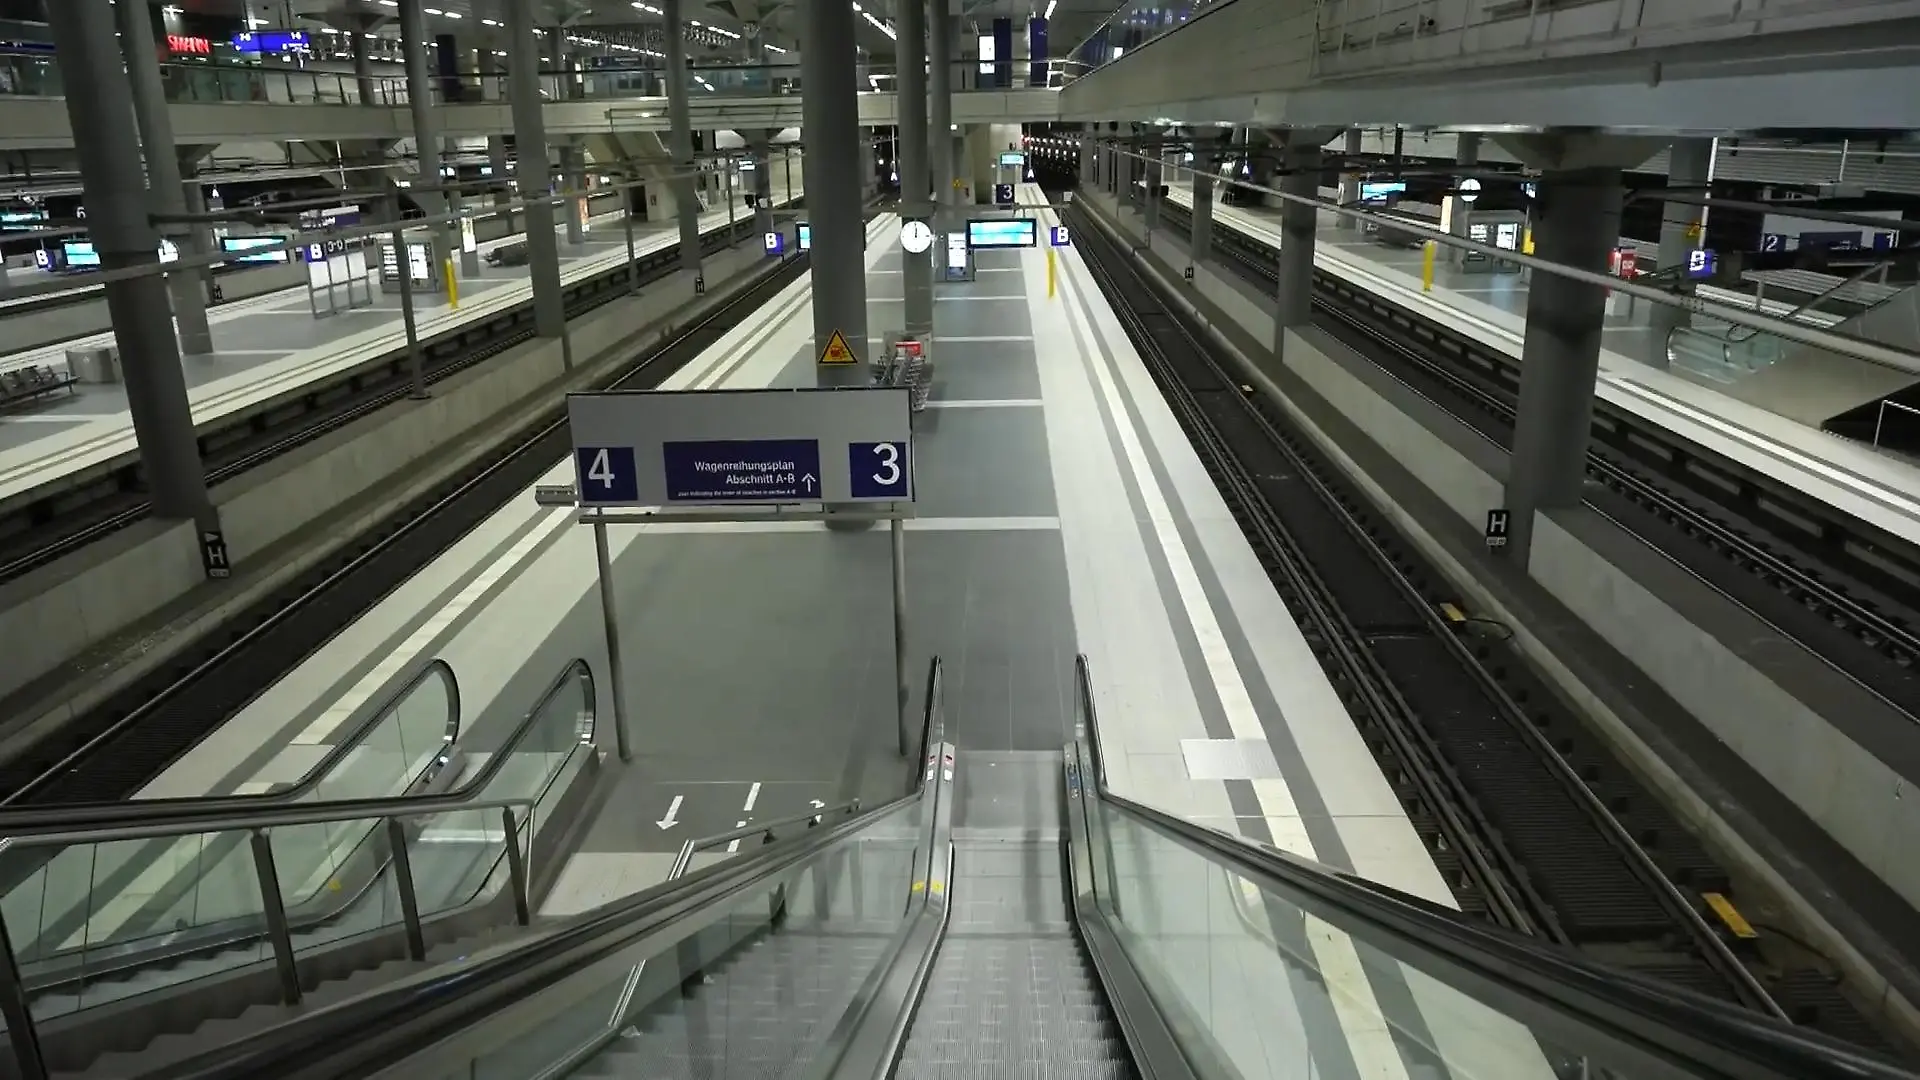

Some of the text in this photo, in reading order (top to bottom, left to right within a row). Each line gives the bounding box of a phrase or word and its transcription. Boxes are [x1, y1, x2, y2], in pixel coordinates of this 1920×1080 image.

[1027, 168, 1034, 178] A
[1003, 185, 1013, 199] 3
[765, 233, 777, 248] B
[1057, 227, 1069, 243] B
[1766, 235, 1778, 251] 2
[35, 250, 49, 266] B
[310, 243, 323, 259] B
[1689, 250, 1705, 271] B
[588, 448, 615, 488] 4
[694, 460, 795, 473] Wagenreihungsplan
[872, 442, 900, 485] 3
[725, 473, 774, 484] Abschnitt
[1490, 513, 1506, 533] H
[208, 545, 224, 565] H
